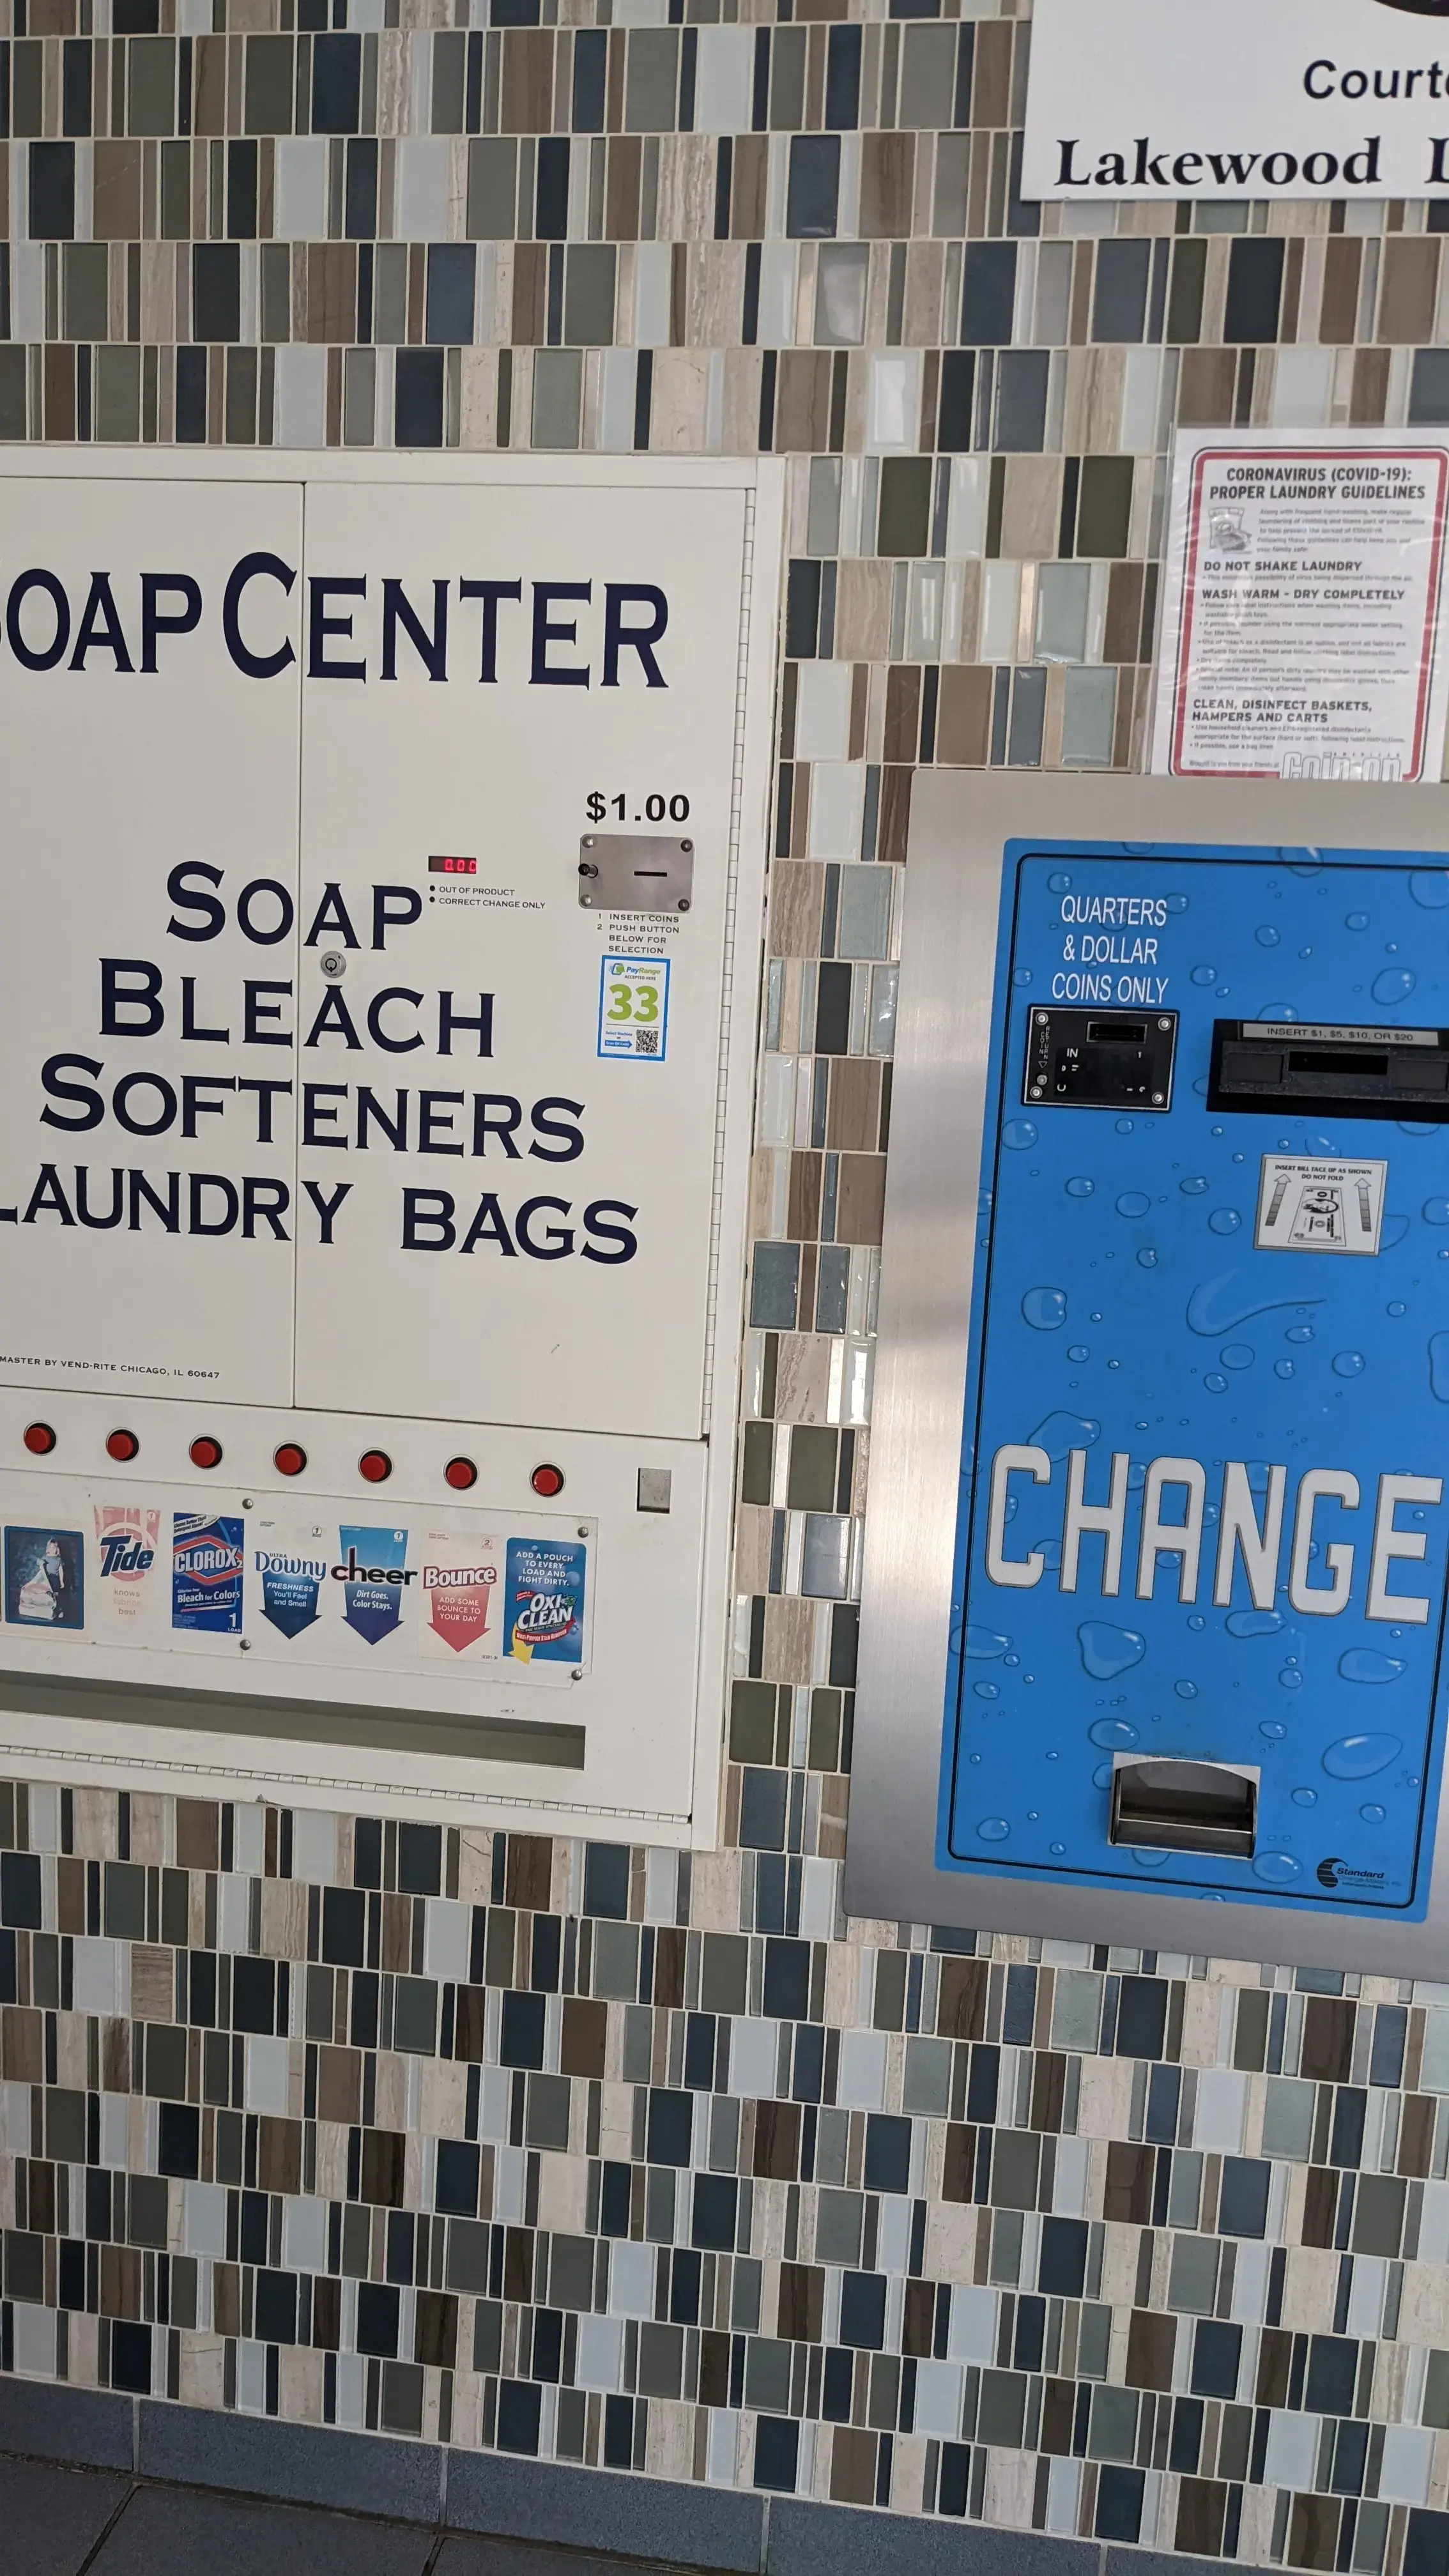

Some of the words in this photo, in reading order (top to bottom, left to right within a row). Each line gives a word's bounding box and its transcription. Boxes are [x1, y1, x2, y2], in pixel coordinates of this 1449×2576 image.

[1303, 59, 1449, 100] Court
[1054, 135, 1382, 186] Lakewood
[1227, 468, 1326, 481] CORONAVIRUS
[1331, 468, 1411, 482] (COVID-19):
[1210, 486, 1264, 499] PROPER
[1270, 486, 1336, 499] LAUNDRY
[1342, 486, 1425, 499] GUIDELINES
[1204, 562, 1220, 571] DO
[1225, 562, 1251, 571] NOT
[1255, 562, 1298, 571] SHAKE
[1302, 562, 1362, 571] LAUNDRY
[1202, 590, 1237, 599] WASH
[1243, 590, 1279, 599] WARM
[1294, 590, 1318, 599] DRY
[1324, 590, 1405, 600] COMPLETELY
[0, 568, 203, 673] OAP
[223, 551, 669, 691] CENTER
[1193, 700, 1238, 710] CLEAN,
[1243, 700, 1305, 710] DISINFECT
[1312, 701, 1372, 712] BASKETS,
[1192, 712, 1250, 722] HAMPERS
[1256, 713, 1282, 722] AND
[1287, 713, 1328, 723] CARTS
[586, 792, 690, 824] $1.00
[166, 861, 424, 951] SOAP
[439, 898, 481, 906] CORRECT
[1061, 896, 1167, 927] QUARTERS
[609, 946, 663, 954] SELECTION
[1063, 935, 1075, 961] &
[1082, 936, 1158, 965] DOLLAR
[1052, 973, 1112, 1001] COINS
[1117, 976, 1169, 1004] ONLY
[98, 958, 495, 1058] BLEACH
[607, 984, 658, 1022] 33
[1268, 1028, 1308, 1036] INSERT
[1311, 1029, 1326, 1038] $1,
[1349, 1031, 1370, 1040] $10,
[1395, 1033, 1413, 1041] $20
[1066, 1048, 1078, 1058] IN
[39, 1053, 586, 1163] SOFTENERS
[401, 1187, 640, 1264] BAGS
[0, 1356, 40, 1365] MASTER
[61, 1360, 117, 1370] VEND-RITE
[121, 1365, 169, 1376] CHICAGO,
[188, 1370, 220, 1379] 60647
[985, 1443, 1443, 1624] CHANGE
[100, 1535, 154, 1577] Tide
[174, 1547, 239, 1573] CLOROX
[544, 1553, 573, 1561] POUCH
[254, 1551, 326, 1581] Downy
[331, 1547, 418, 1585] cheer
[424, 1567, 497, 1588] Bounce
[519, 1575, 542, 1584] FIGHT
[544, 1577, 569, 1586] DIRTY.
[114, 1588, 140, 1597] knows
[267, 1583, 314, 1591] FRESHNESS
[273, 1590, 291, 1598] You'll
[178, 1592, 204, 1603] Bleach
[214, 1590, 240, 1600] Colors
[371, 1591, 388, 1600] Goes.
[530, 1593, 562, 1612] OXI
[353, 1600, 370, 1608] Color
[372, 1602, 392, 1611] Stays.
[437, 1605, 468, 1613] BOUNCE
[229, 1613, 236, 1627] 1
[518, 1606, 572, 1630] CLEAN
[1337, 1867, 1384, 1878] Standard
